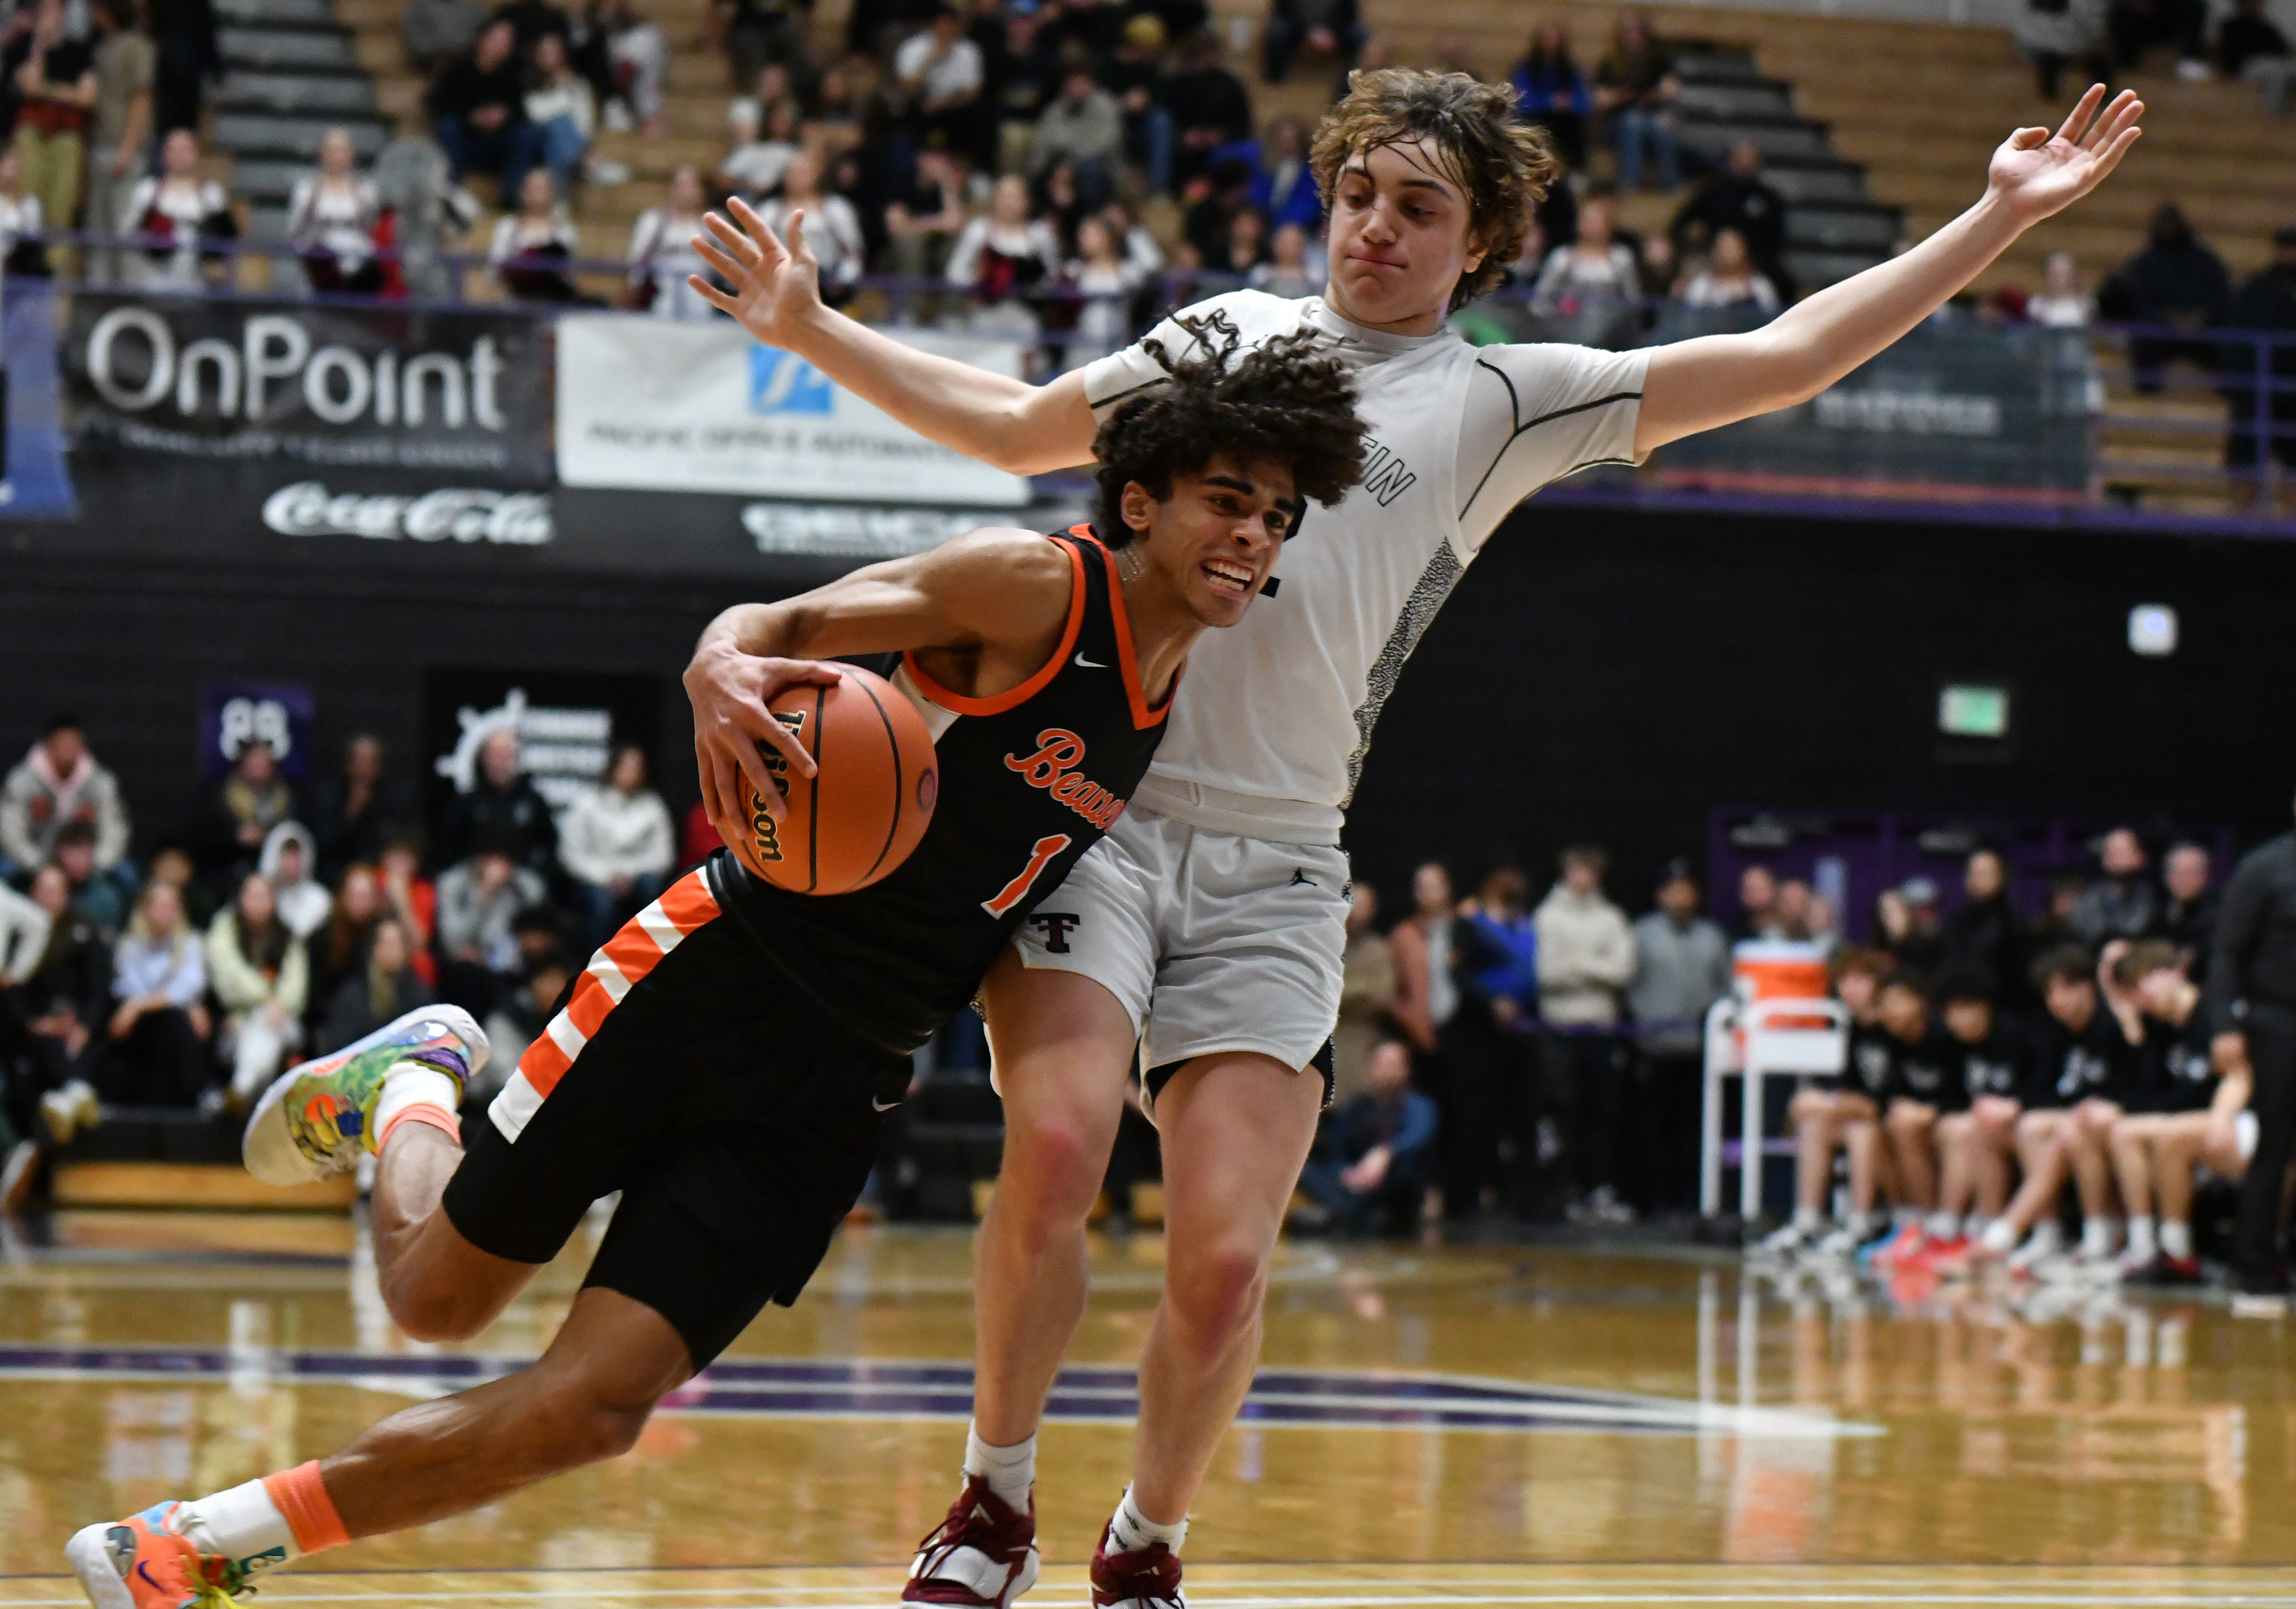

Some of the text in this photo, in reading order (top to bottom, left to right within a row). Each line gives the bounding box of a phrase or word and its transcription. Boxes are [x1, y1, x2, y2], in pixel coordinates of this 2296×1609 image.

[86, 305, 506, 431] OnPoint
[261, 480, 555, 544] Coca-Cola
[980, 833, 1072, 920] 1
